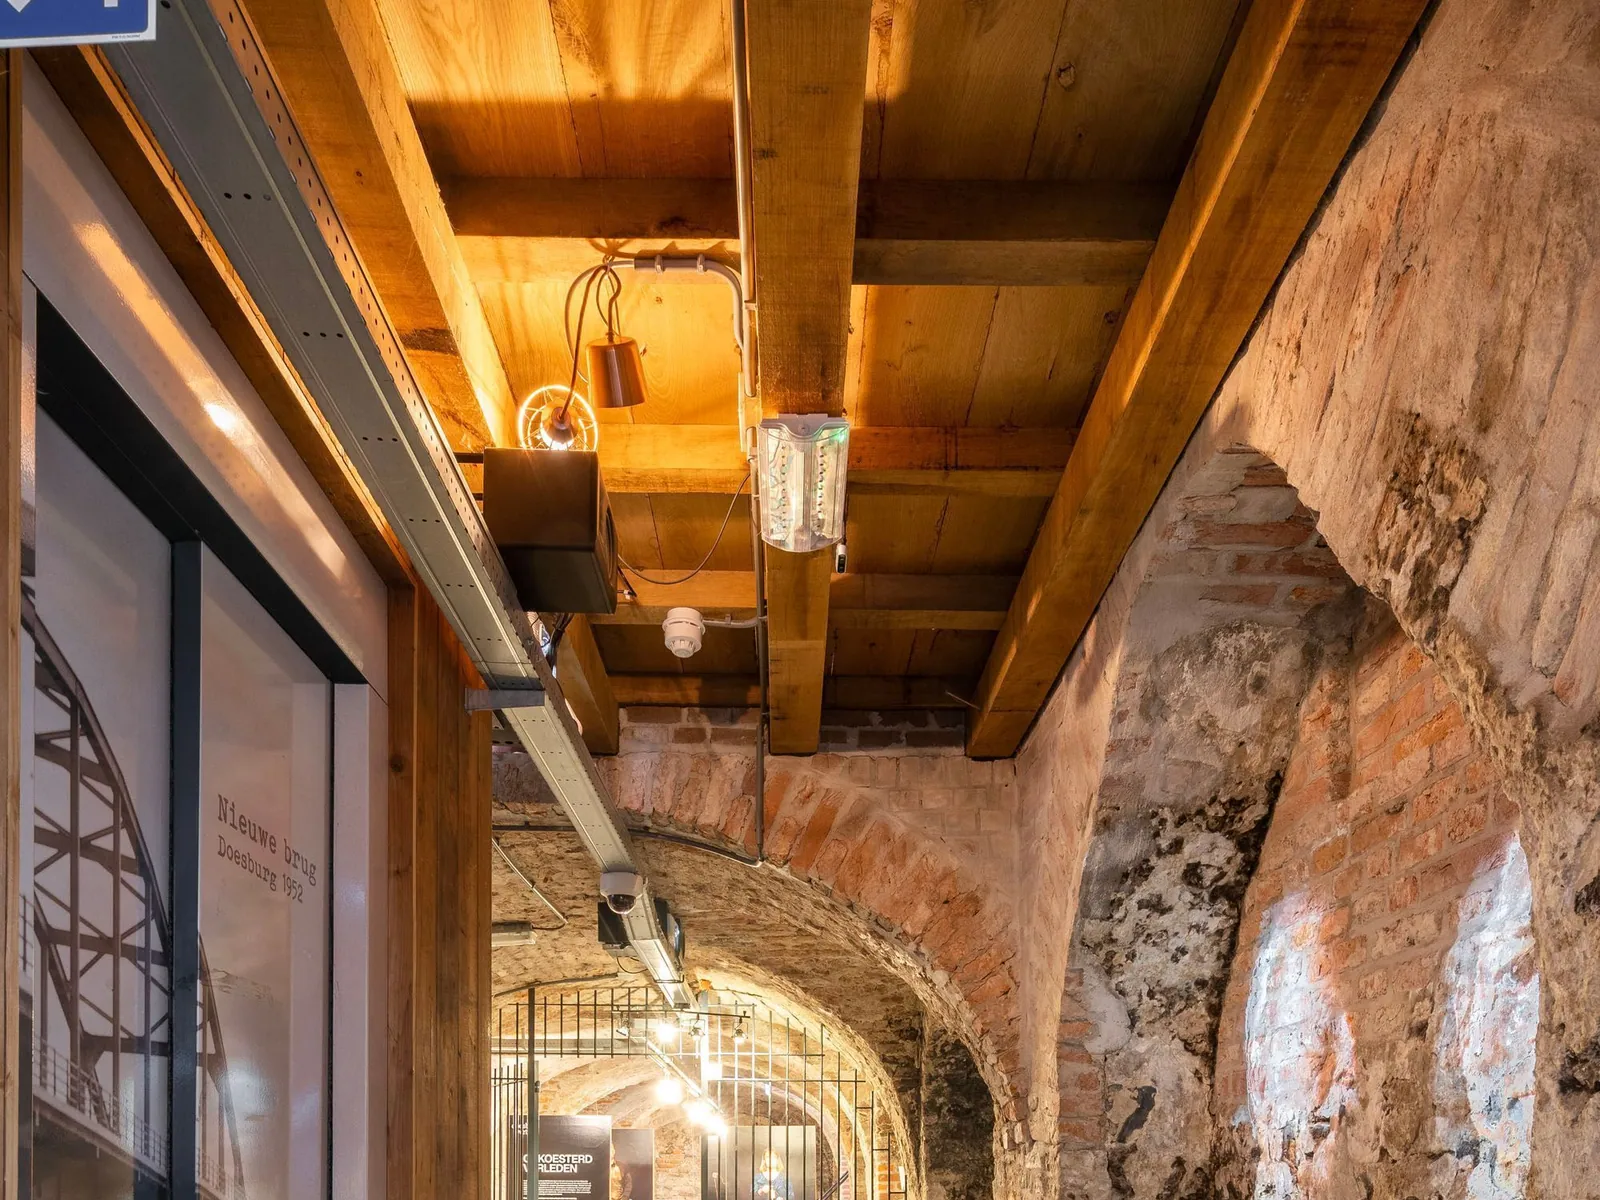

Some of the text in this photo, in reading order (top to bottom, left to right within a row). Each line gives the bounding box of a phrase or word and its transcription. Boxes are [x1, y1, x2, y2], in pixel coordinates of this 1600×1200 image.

[218, 794, 316, 886] Nieuwe brug
[218, 835, 303, 903] Doesburg 1952
[522, 1164, 578, 1173] VRLEDEN
